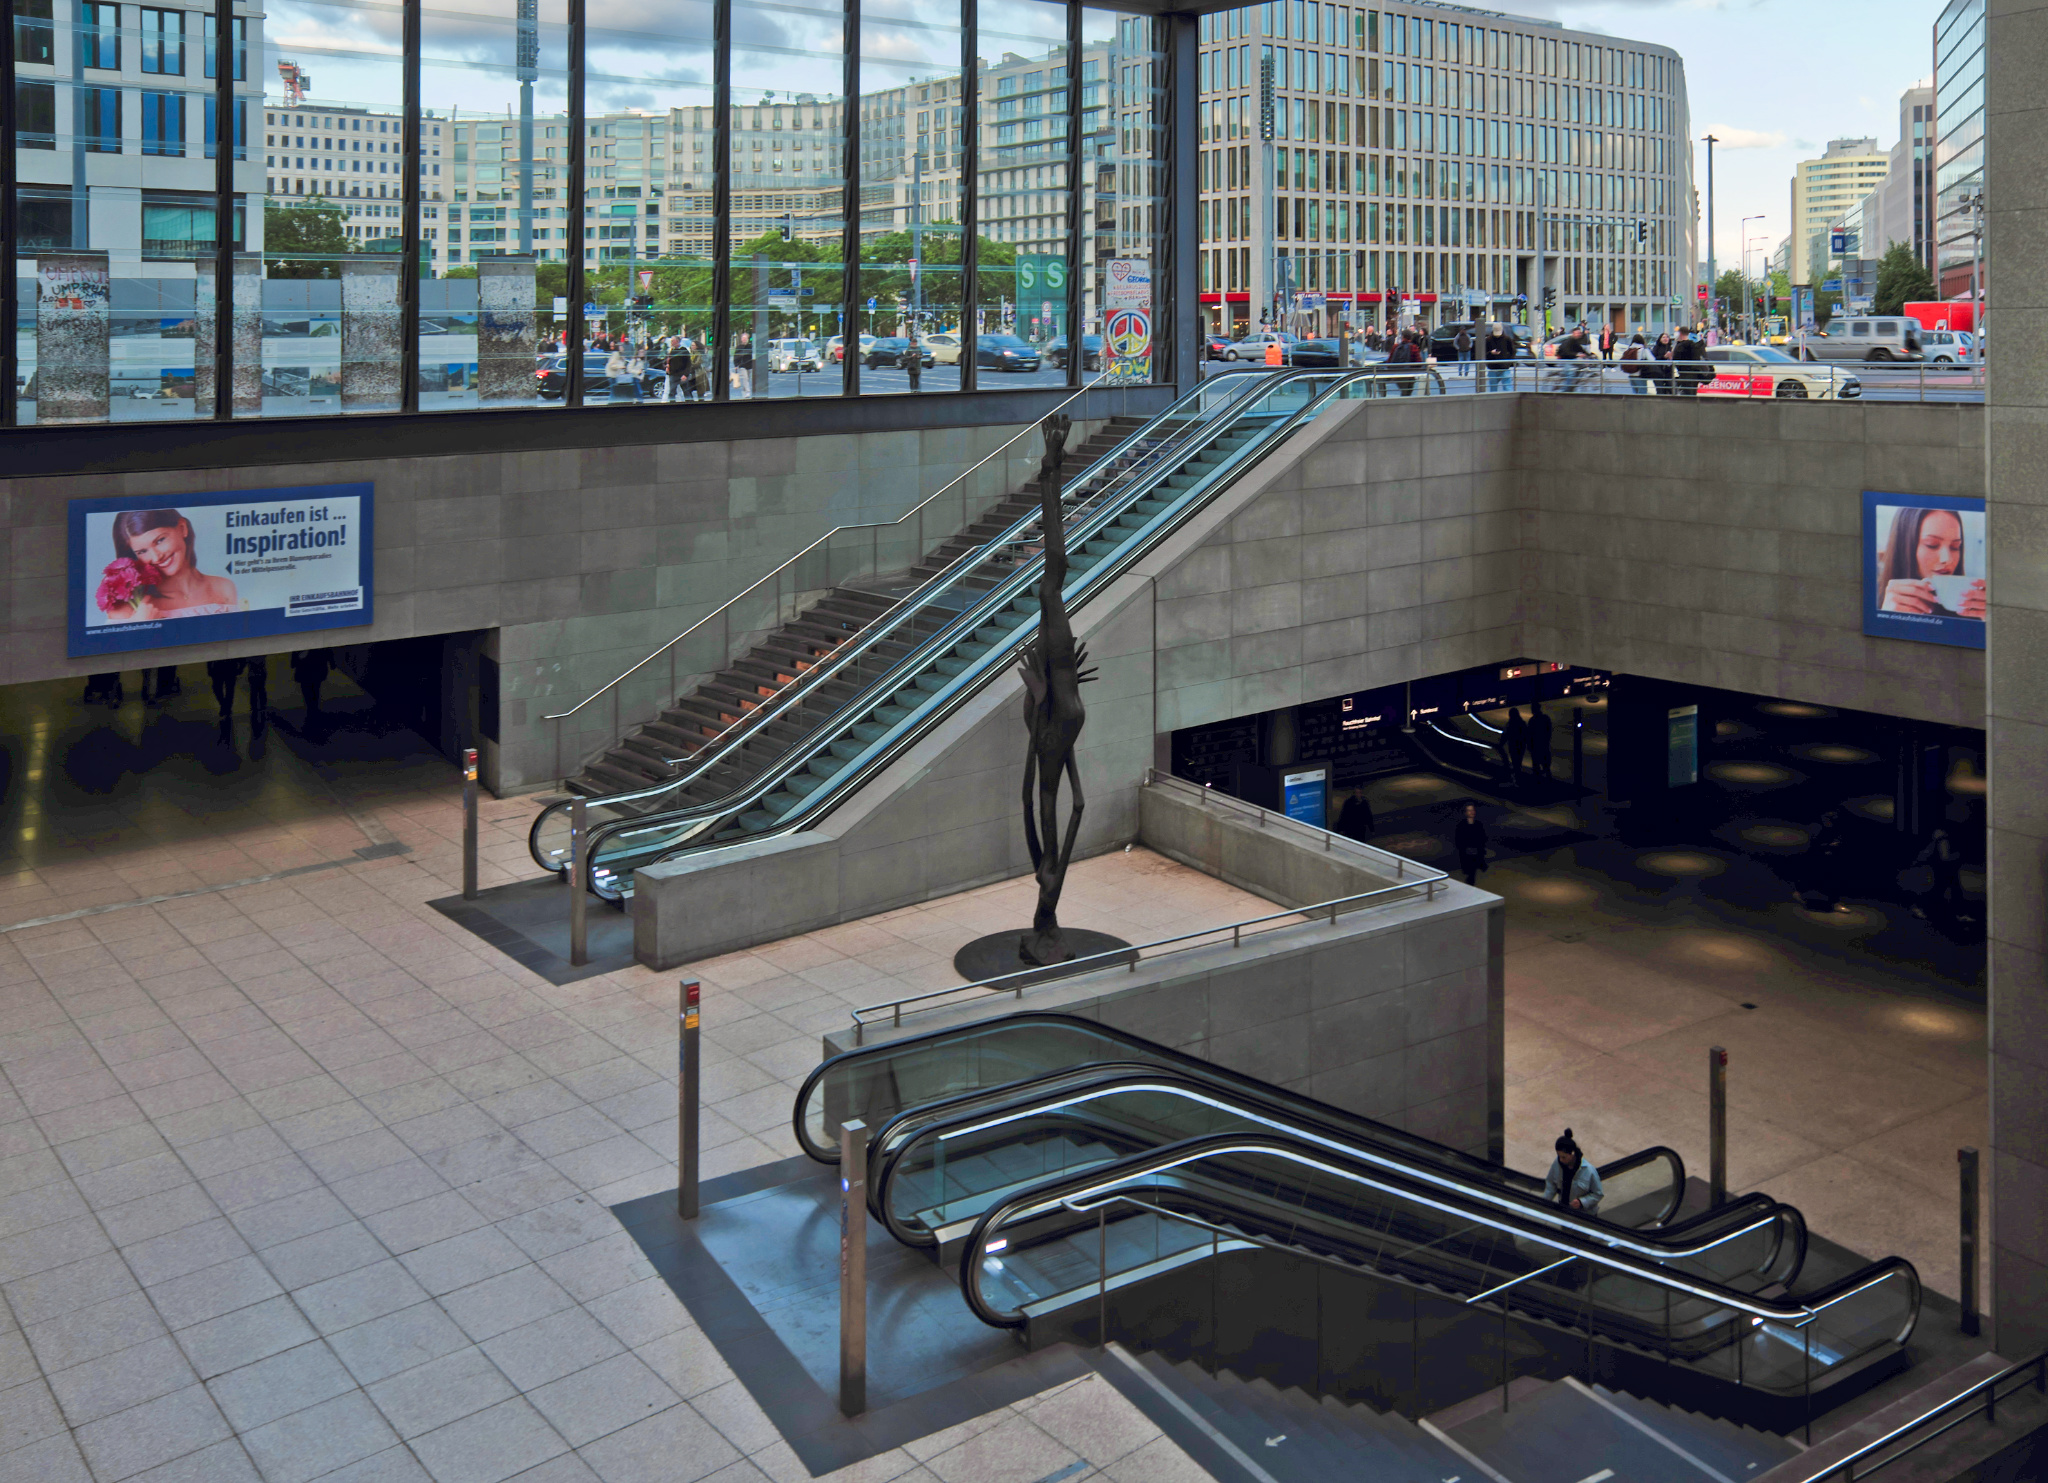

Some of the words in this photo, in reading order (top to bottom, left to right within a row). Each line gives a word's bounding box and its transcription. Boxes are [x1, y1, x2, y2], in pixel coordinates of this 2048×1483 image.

[1021, 262, 1035, 288] S
[1047, 262, 1064, 288] S
[1673, 294, 1682, 304] S
[1832, 303, 1841, 311] U
[225, 507, 305, 528] Einkaufen
[309, 505, 329, 522] ist
[225, 524, 347, 558] Inspiration!
[234, 559, 246, 567] Hier
[289, 595, 300, 603] IHR
[301, 589, 359, 602] EINKAUFSBAHNHOF
